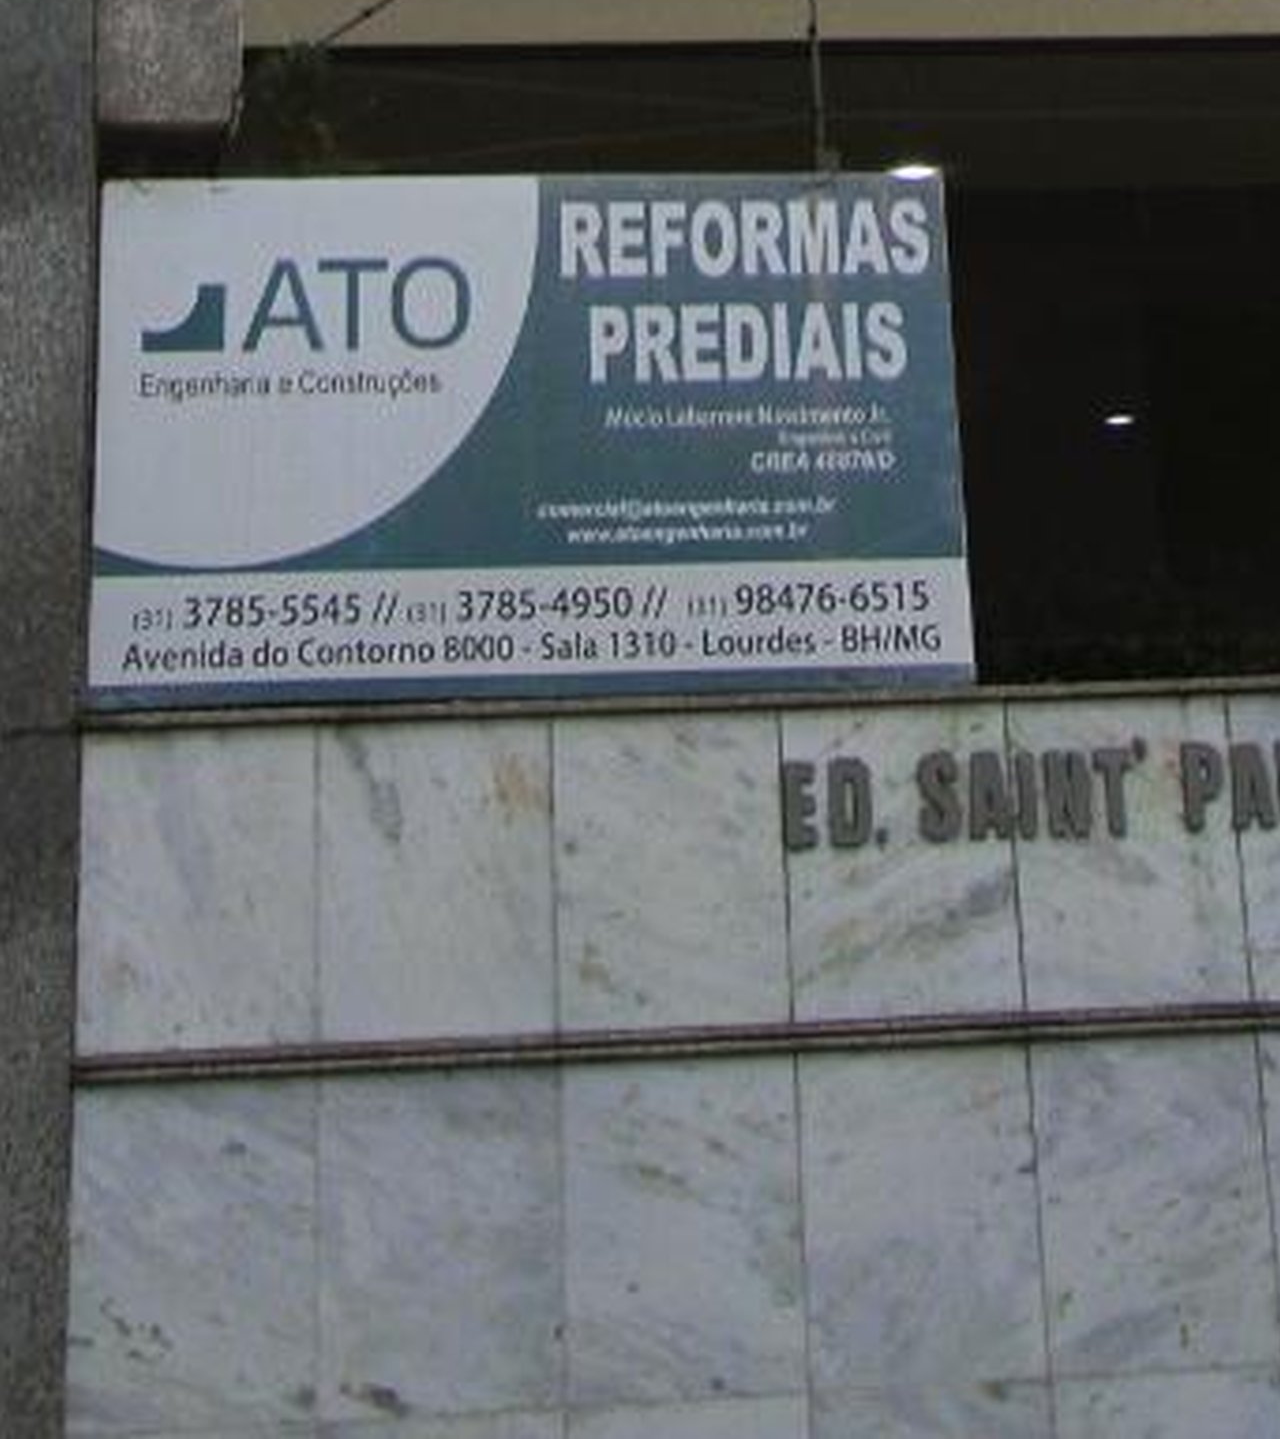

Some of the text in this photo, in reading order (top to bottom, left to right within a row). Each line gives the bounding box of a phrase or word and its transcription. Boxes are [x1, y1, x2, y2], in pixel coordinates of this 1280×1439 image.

[559, 197, 930, 278] REFORMAS
[243, 256, 471, 351] ATO
[589, 300, 908, 383] PREDIAIS
[139, 368, 442, 402] Engenharia e Construções
[751, 451, 810, 473] CREA
[182, 591, 362, 630] 3785-5545
[456, 586, 634, 624] 3785-4950
[734, 579, 930, 616] 98476-6515
[122, 639, 243, 673] Avenida
[253, 638, 289, 669] do
[297, 635, 436, 667] Contorno
[443, 634, 515, 662] 8000
[541, 631, 597, 660] Sala
[610, 629, 676, 659] 1310
[702, 626, 817, 657] Lourdes
[841, 622, 942, 654] BH/MG
[781, 757, 890, 853] ED.
[916, 736, 1147, 843] SAINT'
